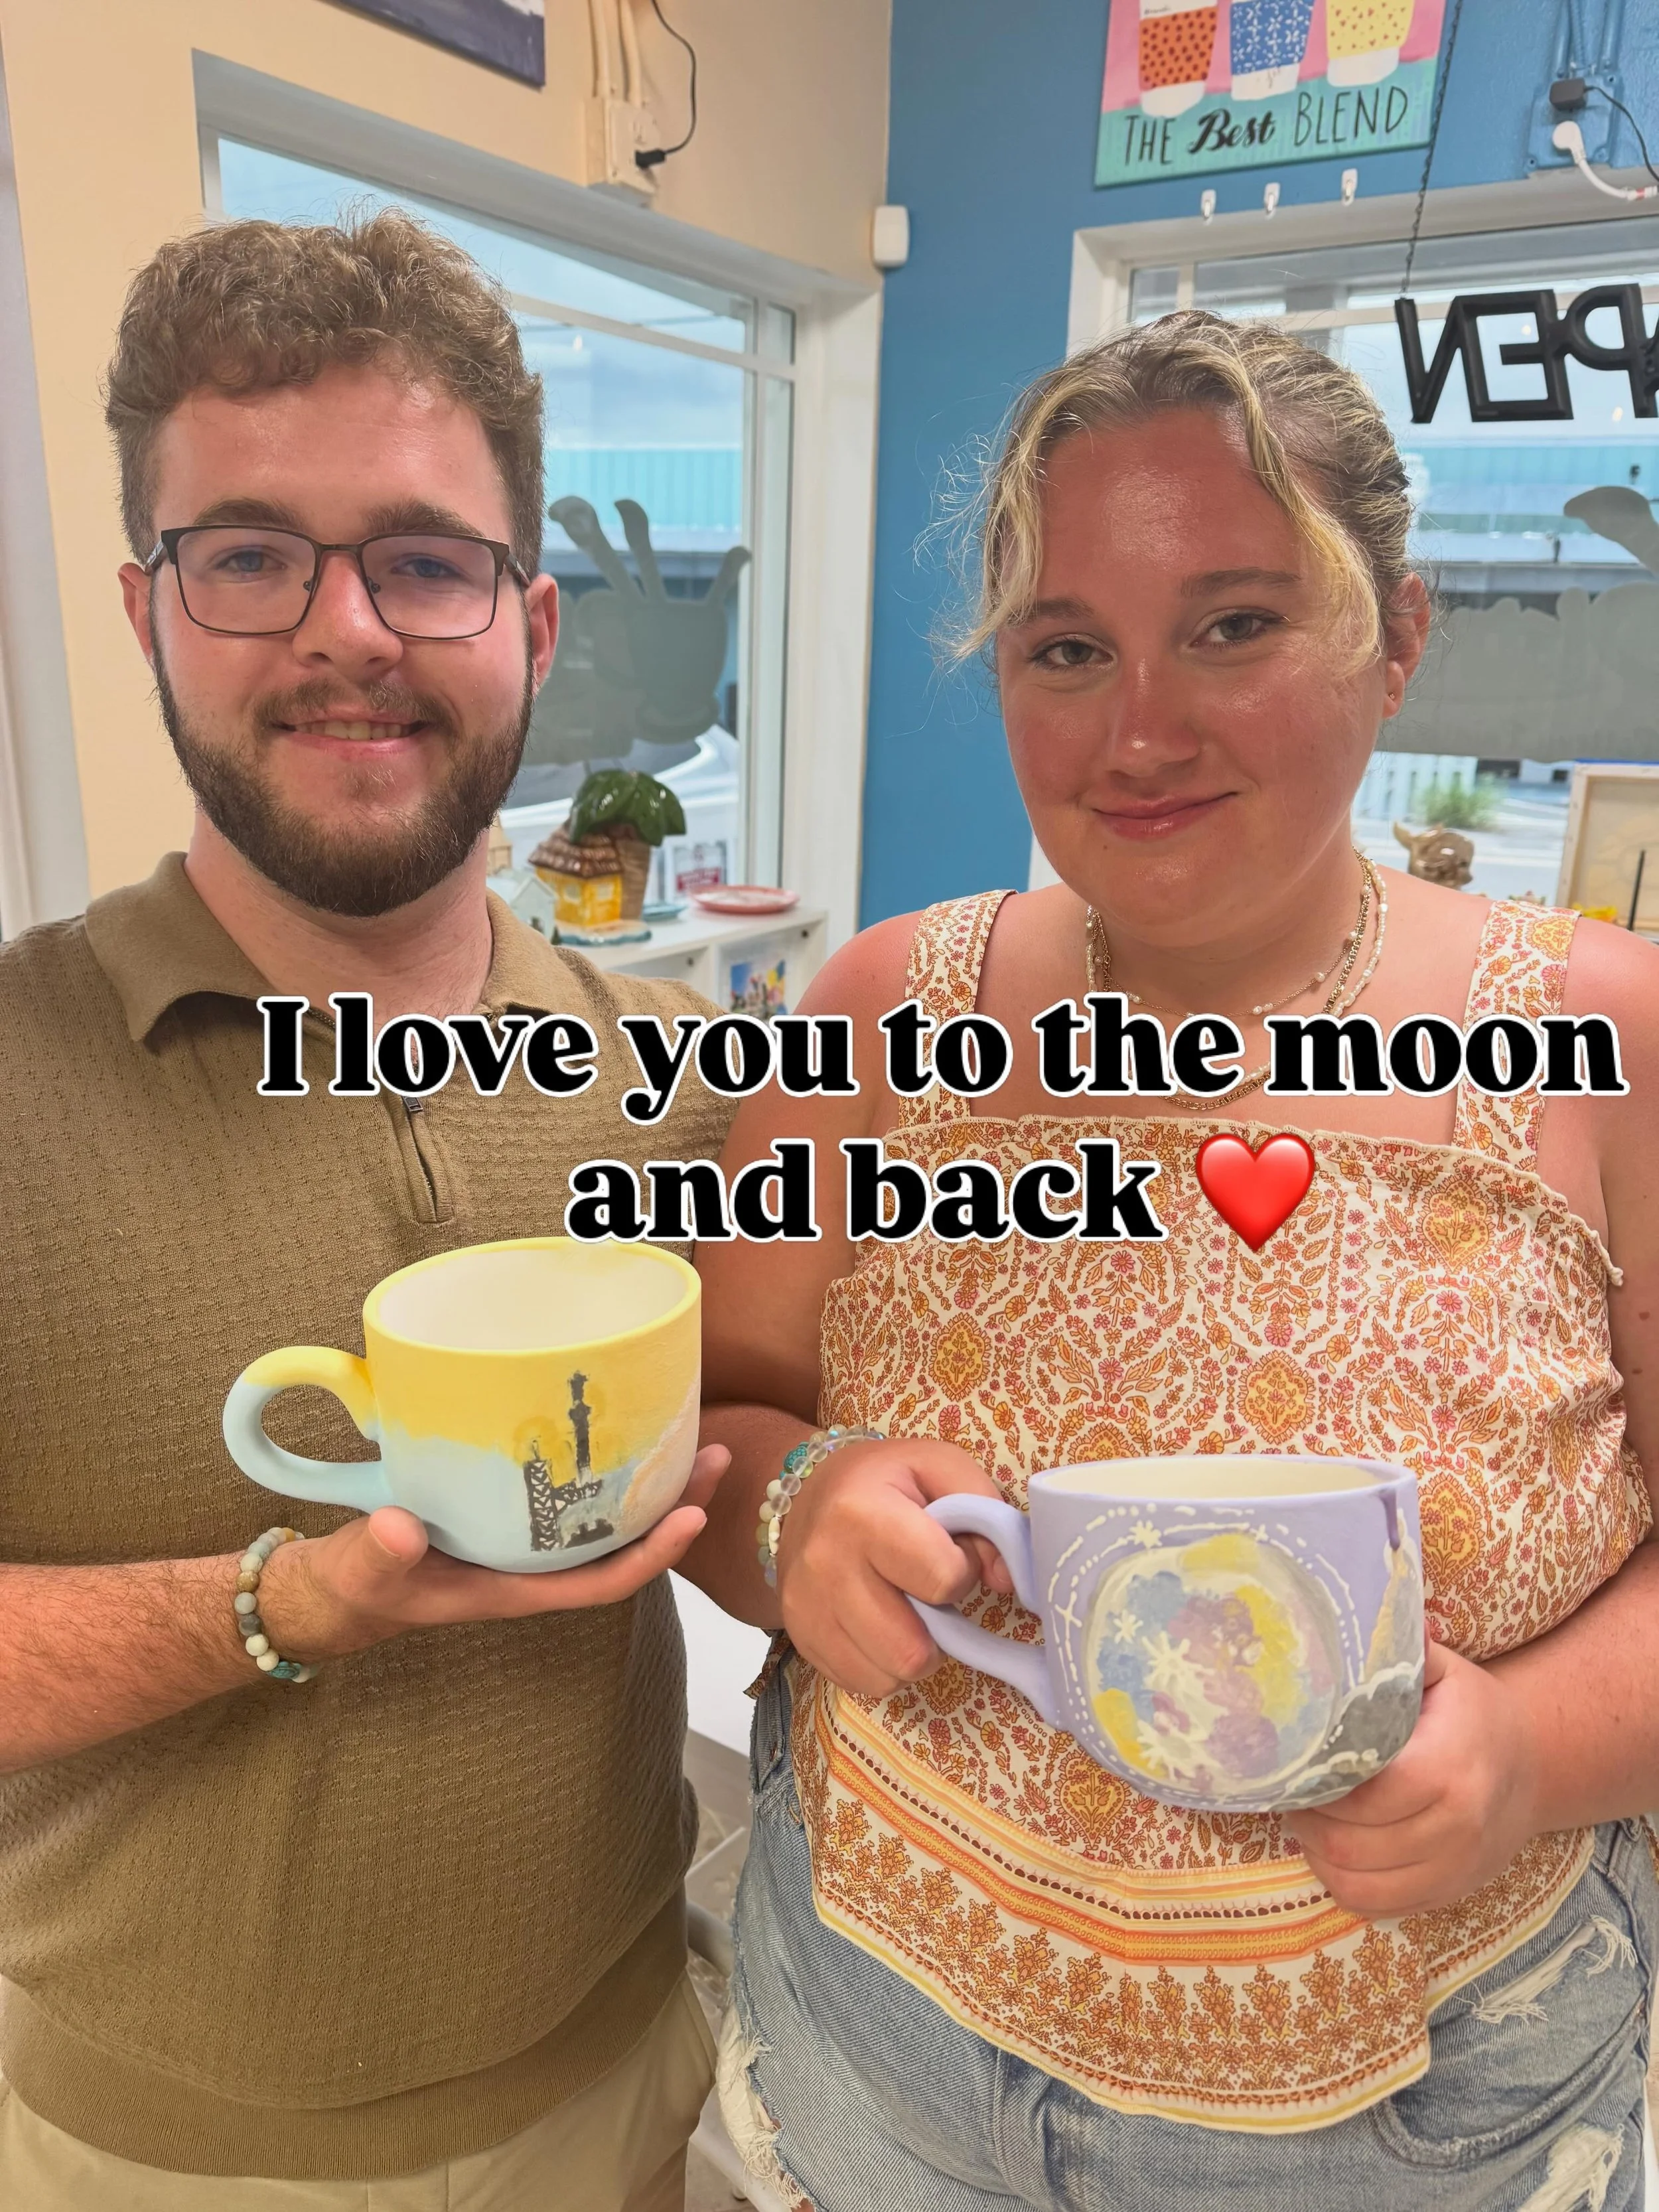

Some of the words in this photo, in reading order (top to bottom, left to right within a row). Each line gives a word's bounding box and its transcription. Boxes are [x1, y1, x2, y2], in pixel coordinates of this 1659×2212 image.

[1124, 114, 1177, 167] THE
[1187, 108, 1277, 155] Best
[1293, 86, 1409, 147] BLEND
